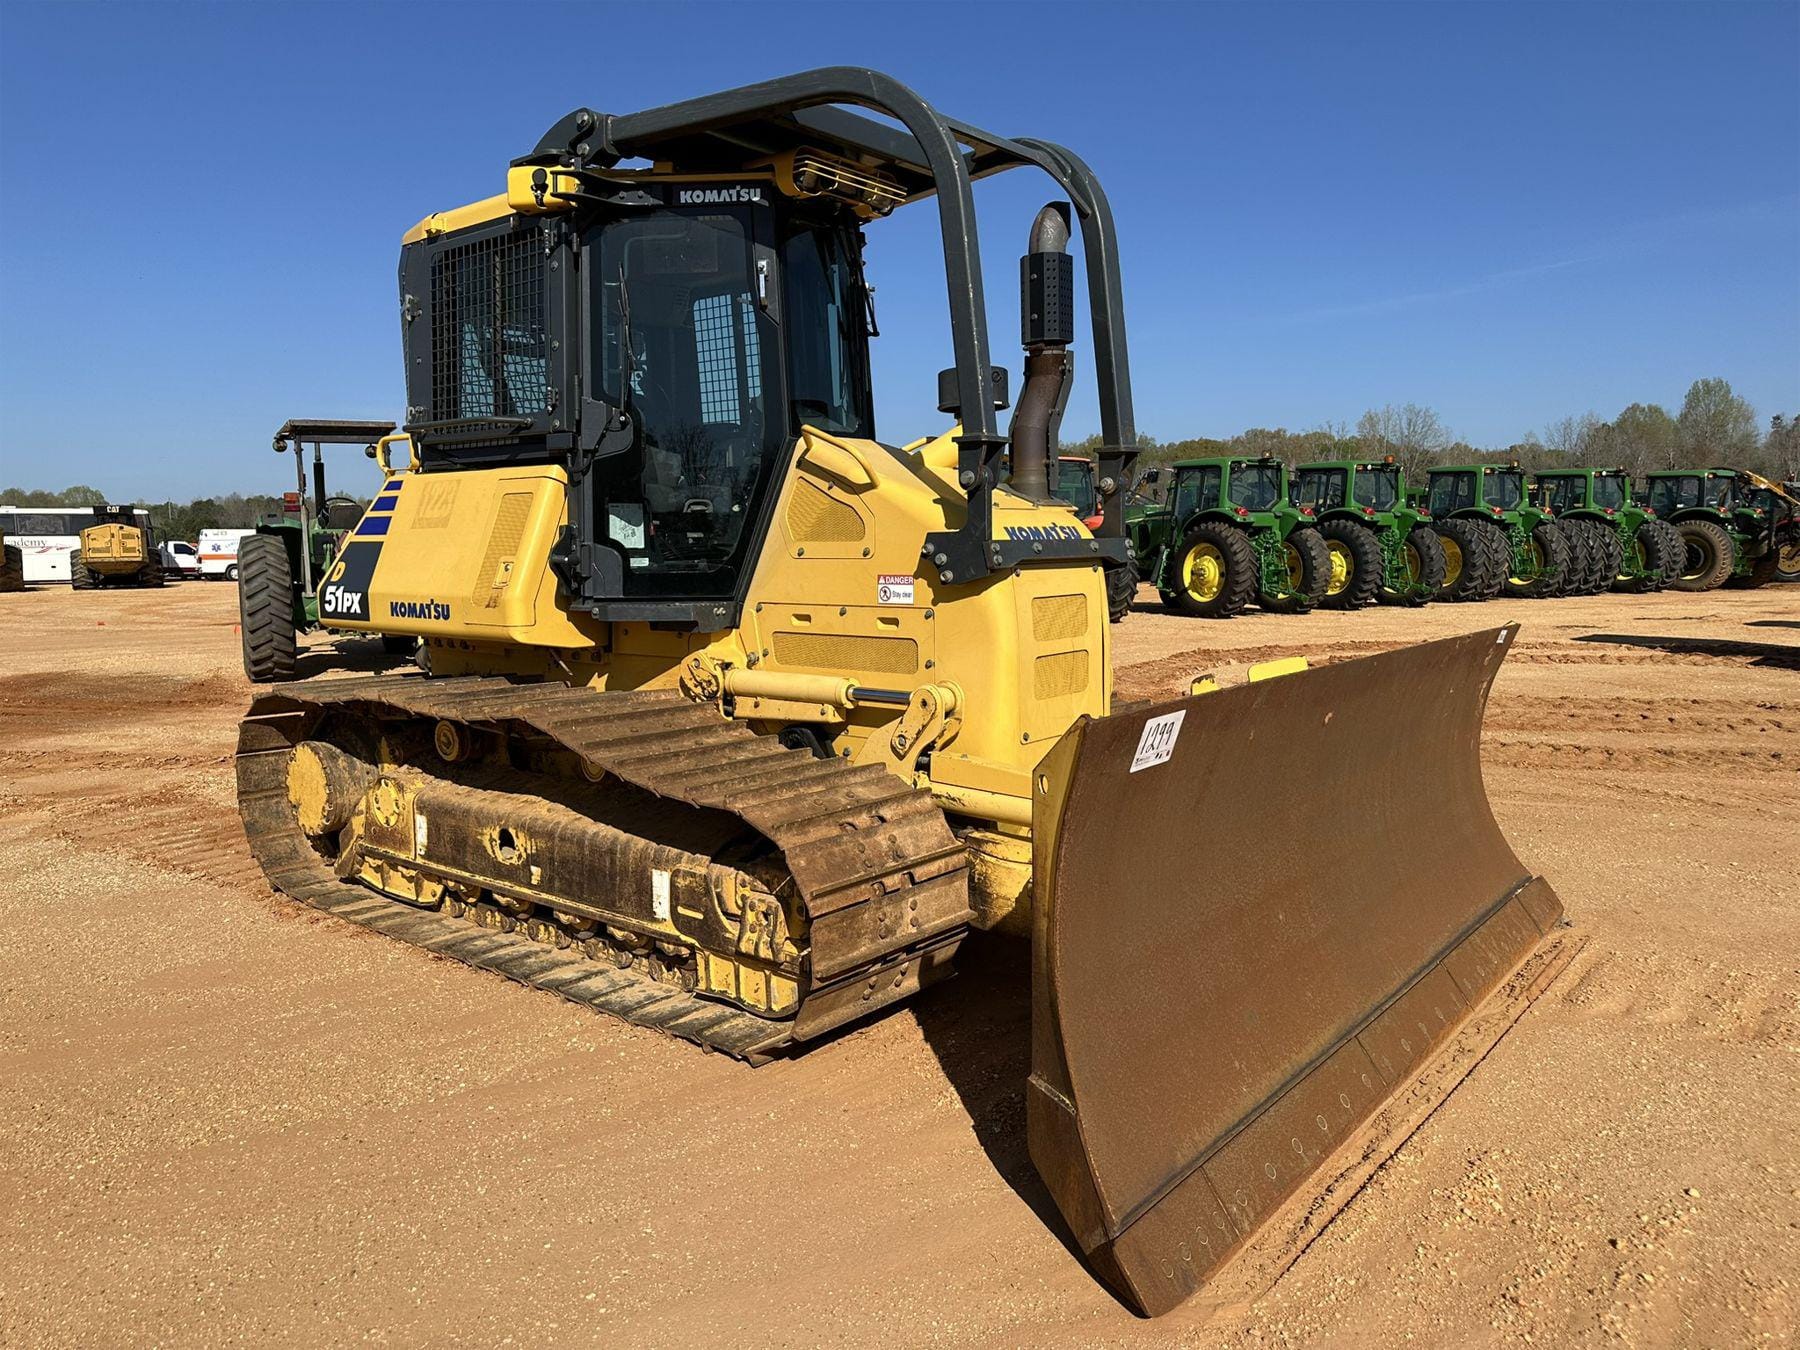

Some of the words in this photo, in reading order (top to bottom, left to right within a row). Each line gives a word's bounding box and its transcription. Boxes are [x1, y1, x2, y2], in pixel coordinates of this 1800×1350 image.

[680, 185, 761, 204] KOMATSU
[1003, 522, 1082, 541] KOMATSU
[330, 561, 346, 582] D
[885, 576, 914, 584] DANGER
[324, 585, 362, 614] 51PX
[390, 598, 450, 620] KOMATSU
[1140, 721, 1175, 756] 1299
